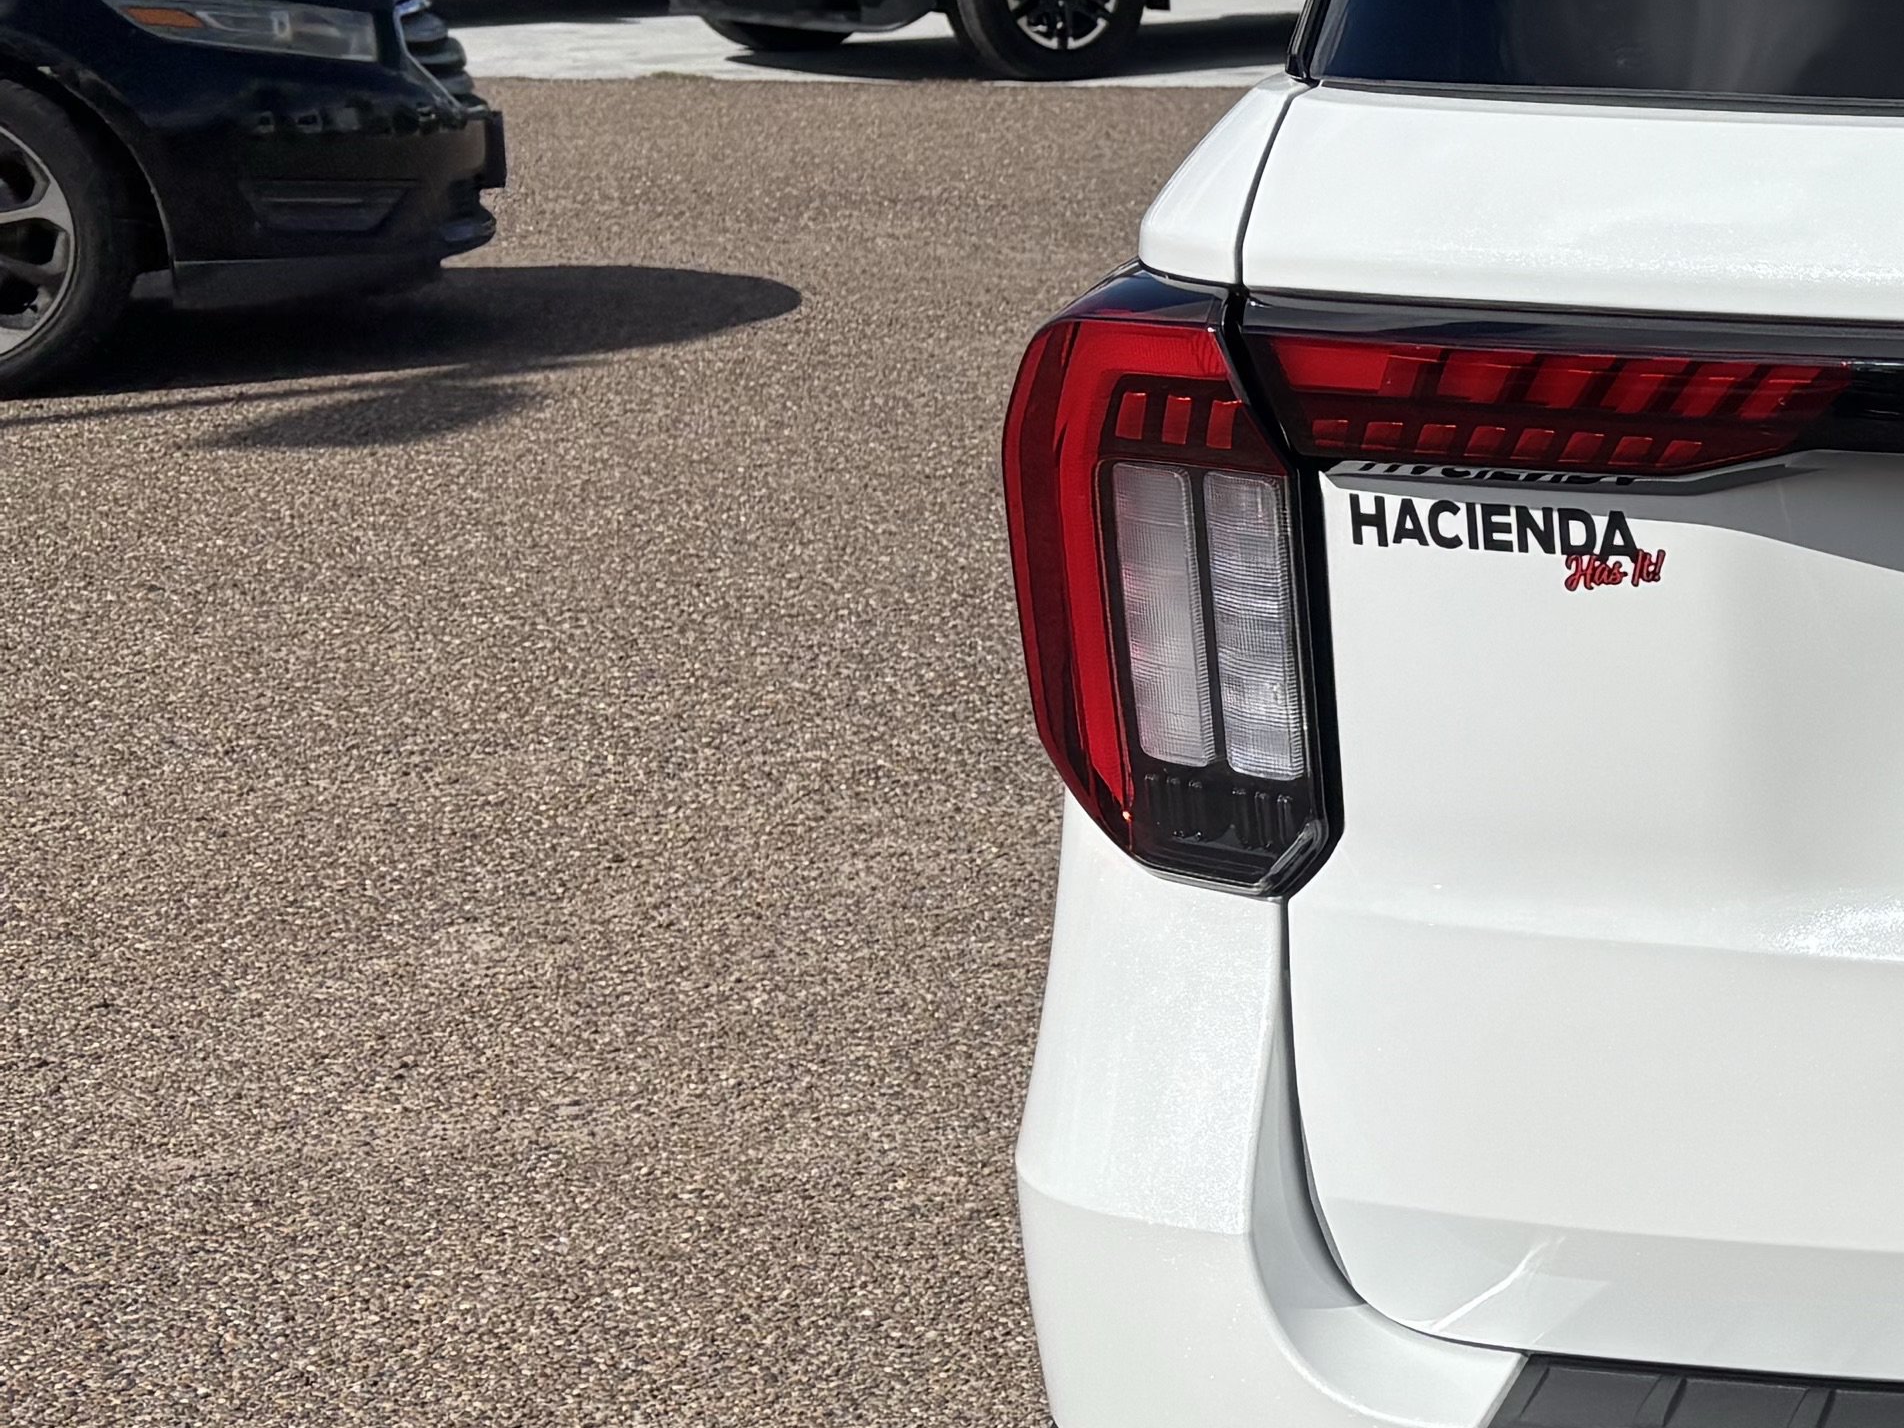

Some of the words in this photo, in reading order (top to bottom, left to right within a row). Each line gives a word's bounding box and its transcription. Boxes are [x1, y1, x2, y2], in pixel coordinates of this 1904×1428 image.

[1350, 492, 1641, 564] HACIENDA
[1564, 552, 1628, 592] Has
[1631, 548, 1666, 587] It!
